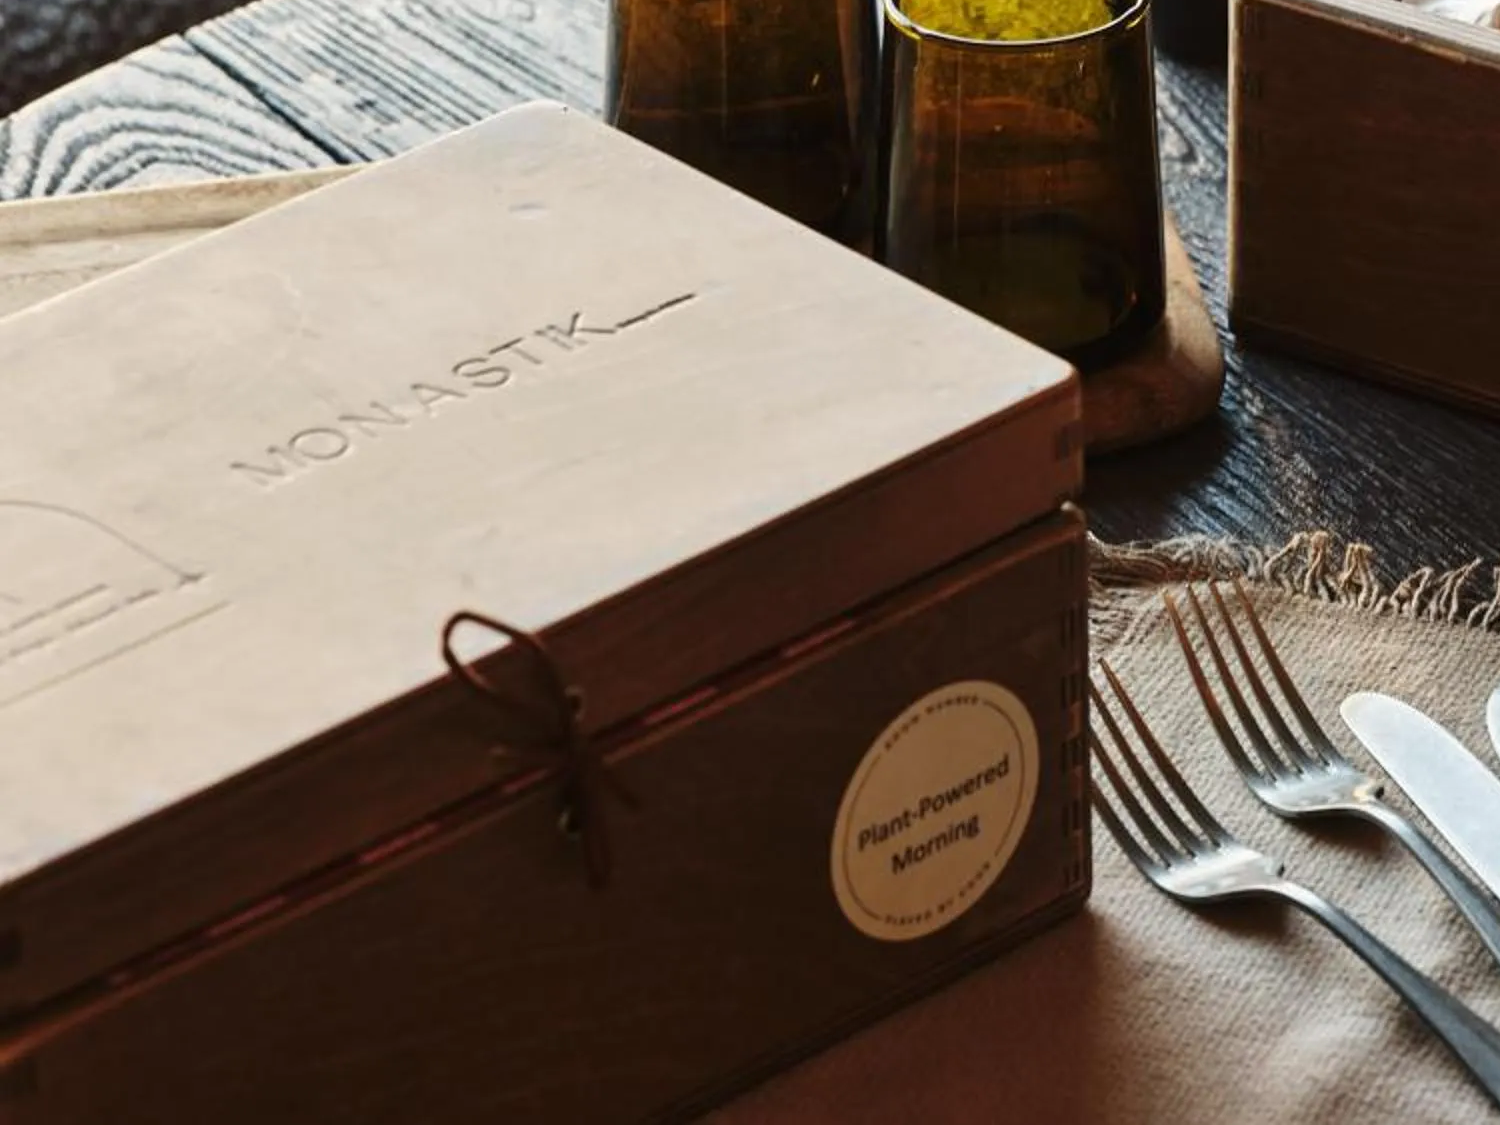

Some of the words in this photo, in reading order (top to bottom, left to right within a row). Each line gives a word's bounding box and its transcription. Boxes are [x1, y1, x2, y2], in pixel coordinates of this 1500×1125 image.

[229, 311, 618, 488] MONASTIK
[857, 754, 1010, 853] Plant-Powered
[891, 814, 981, 876] Morning
